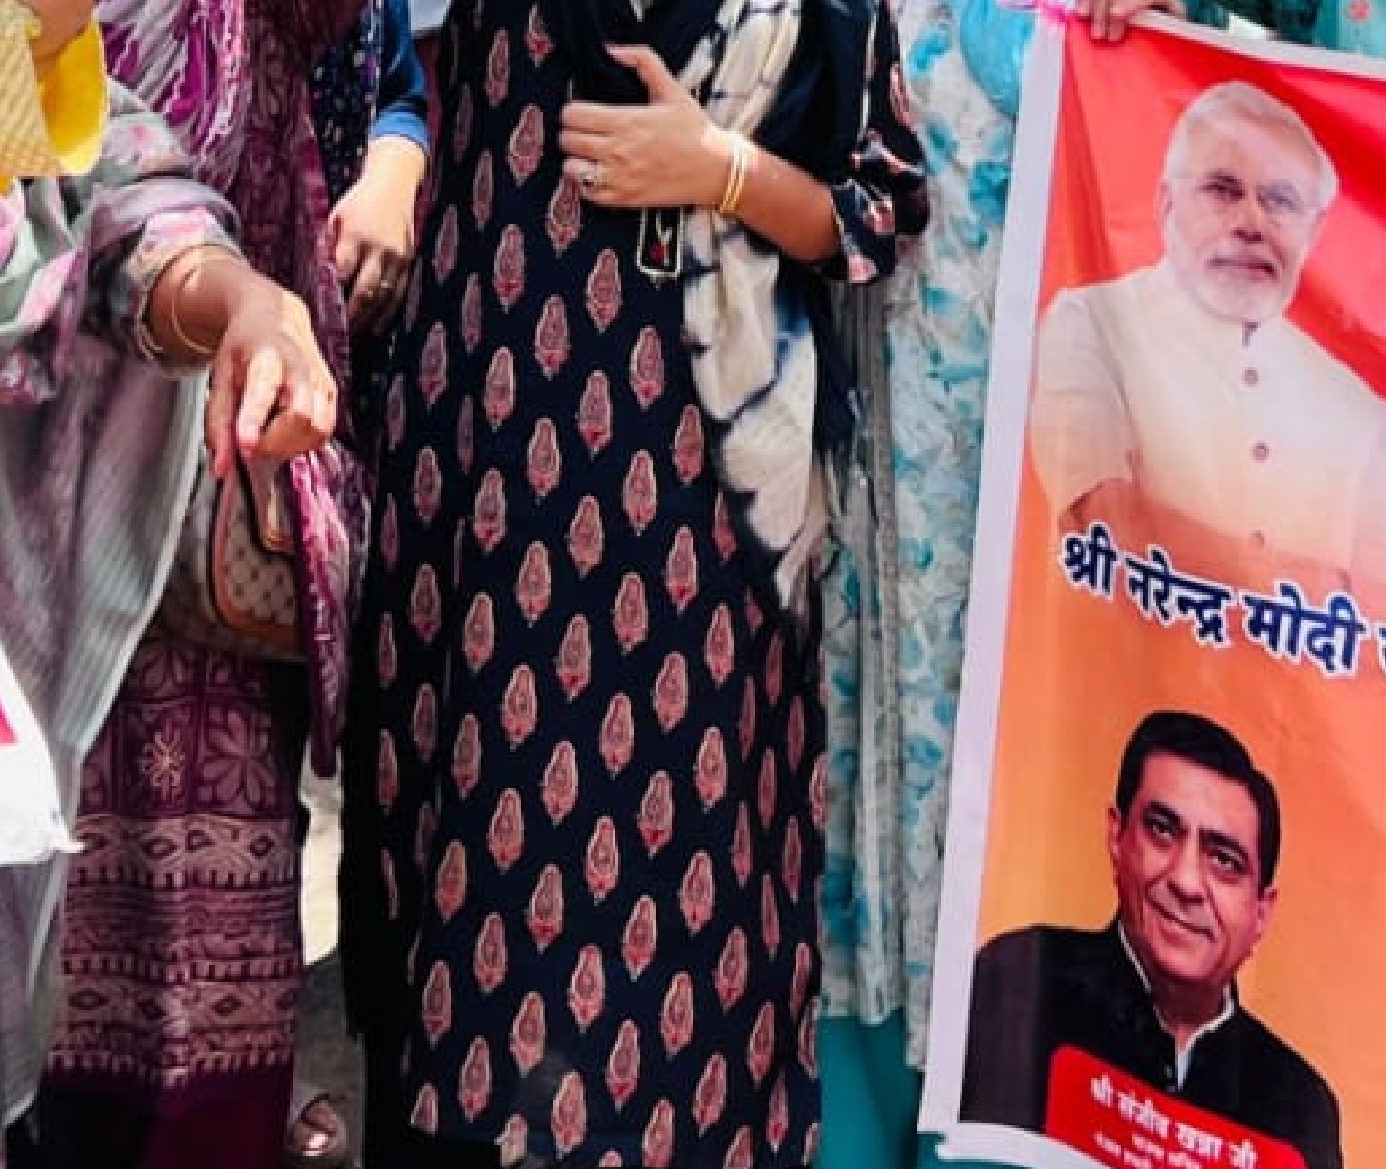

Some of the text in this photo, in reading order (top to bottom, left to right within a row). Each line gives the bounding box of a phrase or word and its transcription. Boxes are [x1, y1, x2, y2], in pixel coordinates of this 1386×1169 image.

[1058, 522, 1121, 598] श्री
[1124, 552, 1231, 649] नरेन्द्र
[1241, 585, 1364, 677] मोदी
